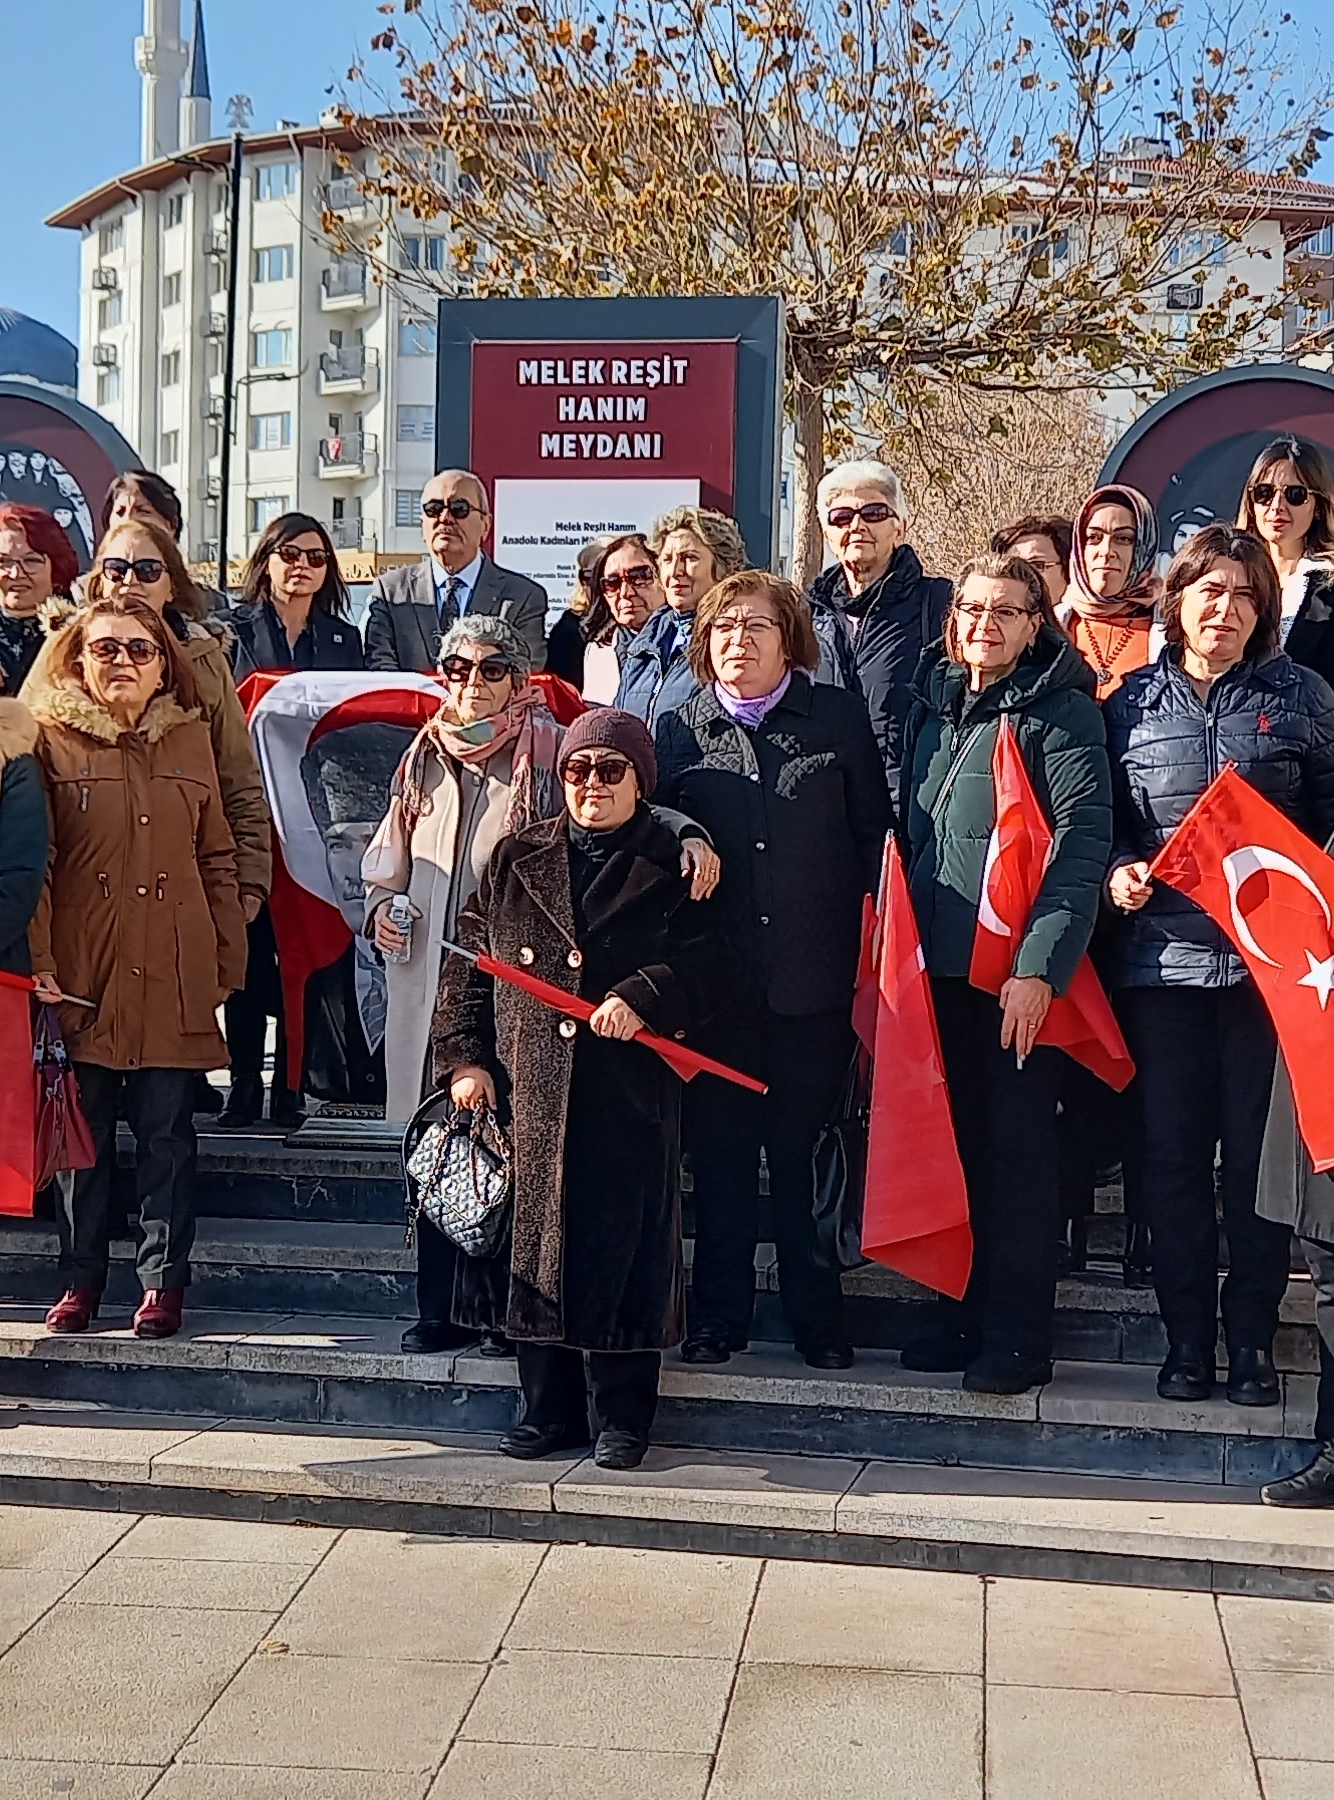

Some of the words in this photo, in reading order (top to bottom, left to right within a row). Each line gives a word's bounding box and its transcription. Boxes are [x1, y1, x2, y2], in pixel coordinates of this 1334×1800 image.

[519, 360, 606, 384] MELEK
[611, 355, 688, 388] REŞİT
[559, 397, 646, 421] HANIM
[541, 433, 662, 458] MEYDANI
[555, 521, 582, 532] Melek
[583, 522, 606, 533] Reşit
[607, 522, 636, 532] Hanım
[502, 535, 538, 545] Anadolu
